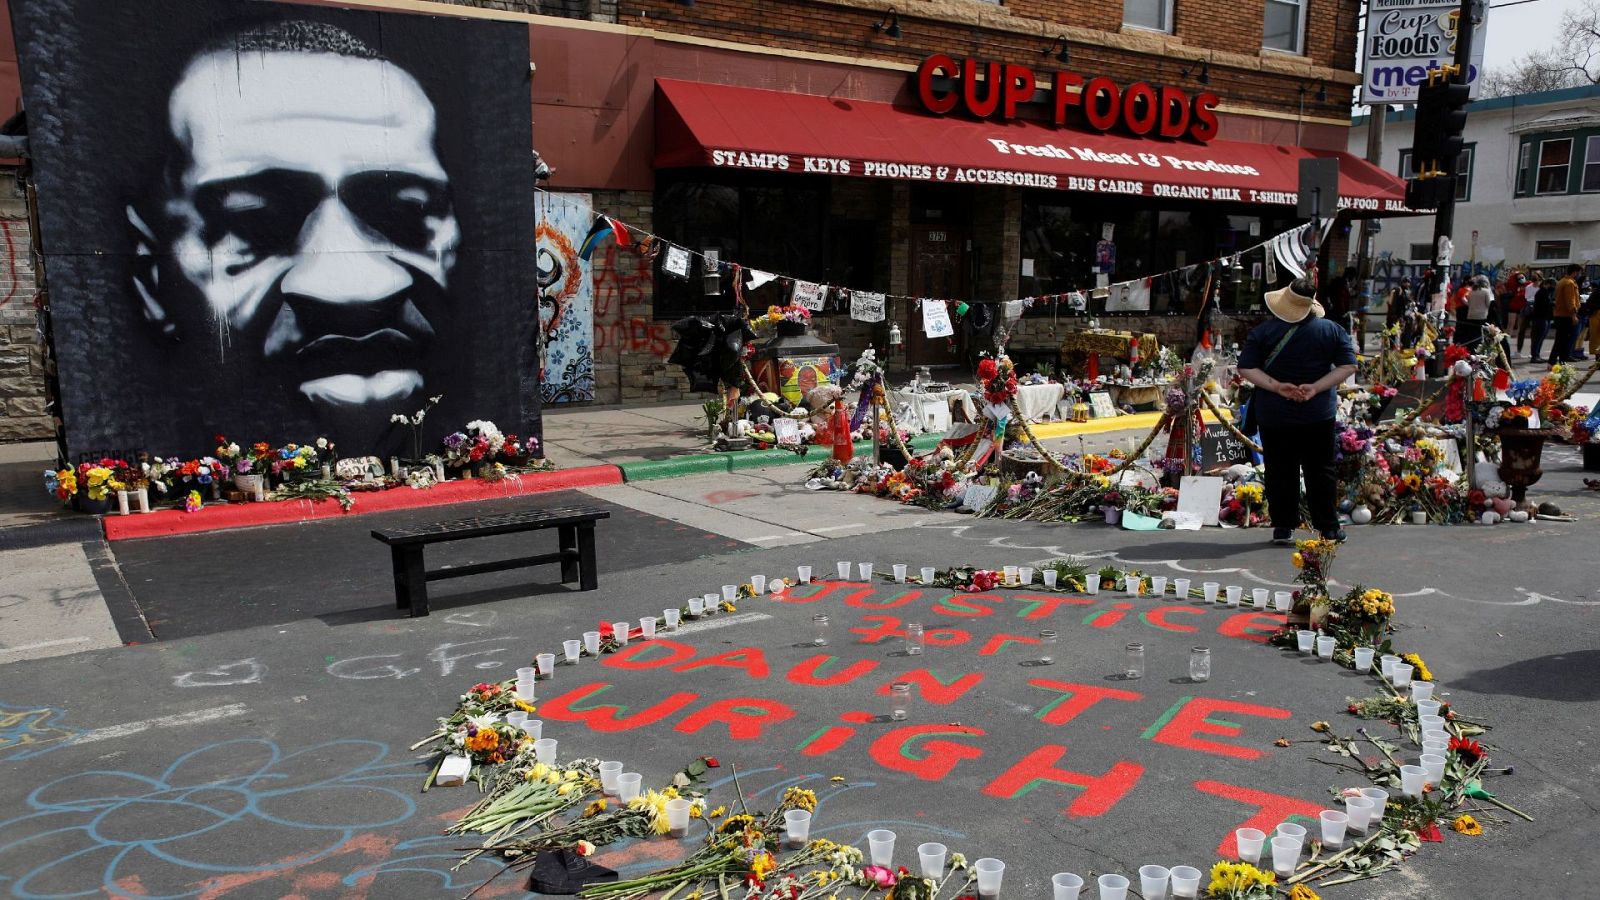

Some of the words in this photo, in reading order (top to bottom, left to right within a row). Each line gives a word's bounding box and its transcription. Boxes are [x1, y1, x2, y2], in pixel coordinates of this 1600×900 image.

[1380, 10, 1437, 38] Cup
[1371, 34, 1440, 56] Foods
[1371, 60, 1477, 87] met
[918, 53, 1036, 119] CUP
[1055, 71, 1221, 142] FOODS
[987, 138, 1074, 160] Fresh
[1070, 146, 1140, 166] Meat
[1138, 152, 1161, 168] &
[1162, 154, 1260, 176] Produce
[712, 149, 790, 170] STAMPS
[803, 157, 851, 175] KEYS
[863, 161, 932, 180] PHONES
[935, 166, 950, 181] &
[953, 167, 1058, 189] ACCESSORIES
[1068, 176, 1096, 191] BUS
[1098, 178, 1143, 195] CARDS
[1152, 183, 1211, 200] ORGANIC
[1211, 187, 1243, 201] MILK
[1249, 190, 1298, 205] T-SHIRTS
[1353, 198, 1379, 210] FOOD
[1216, 440, 1223, 452] A
[1216, 452, 1226, 462] Is
[1228, 449, 1248, 461] Still
